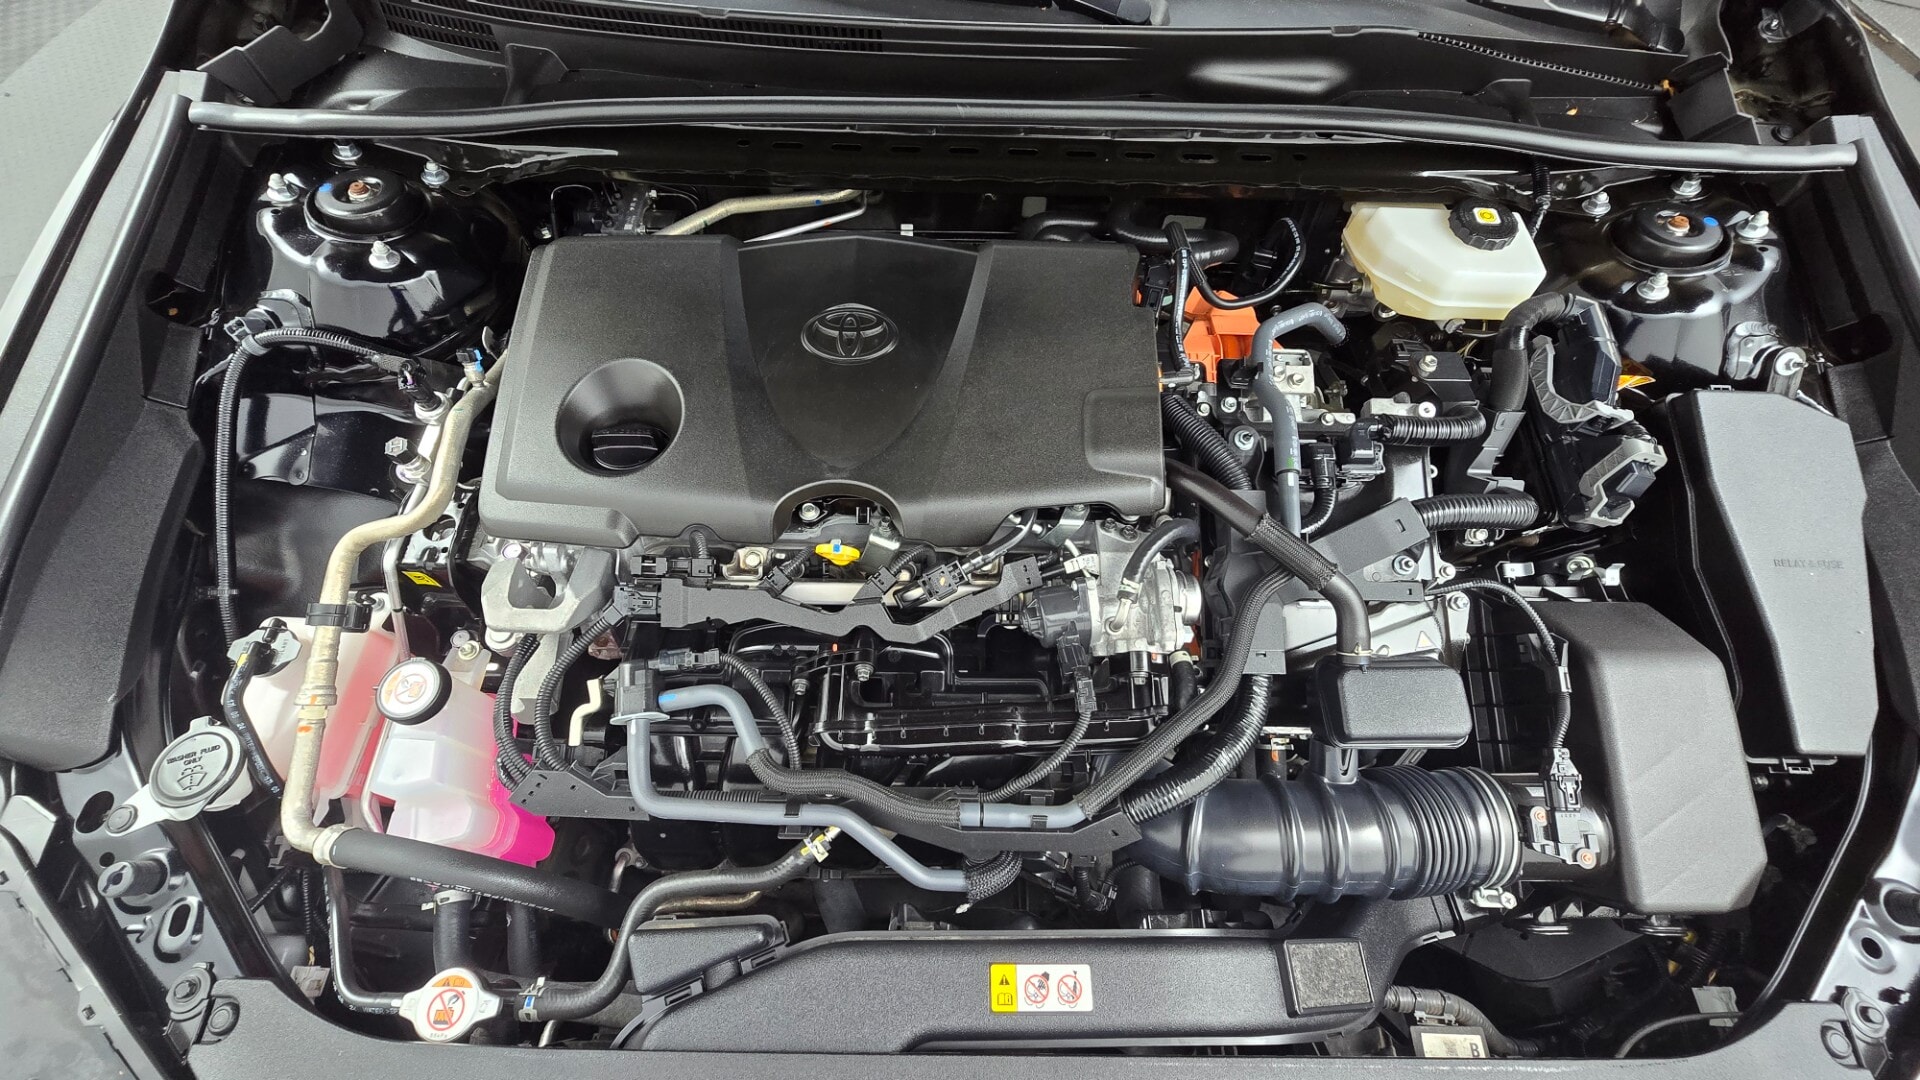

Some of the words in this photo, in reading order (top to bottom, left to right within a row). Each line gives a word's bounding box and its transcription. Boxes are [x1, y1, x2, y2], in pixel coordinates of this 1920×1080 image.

[1773, 558, 1806, 568] RELAY
[1817, 559, 1845, 570] FUSE
[166, 751, 197, 765] WASHER
[200, 744, 221, 755] FLUID
[183, 756, 203, 766] ONLY
[1470, 1042, 1481, 1058] B
